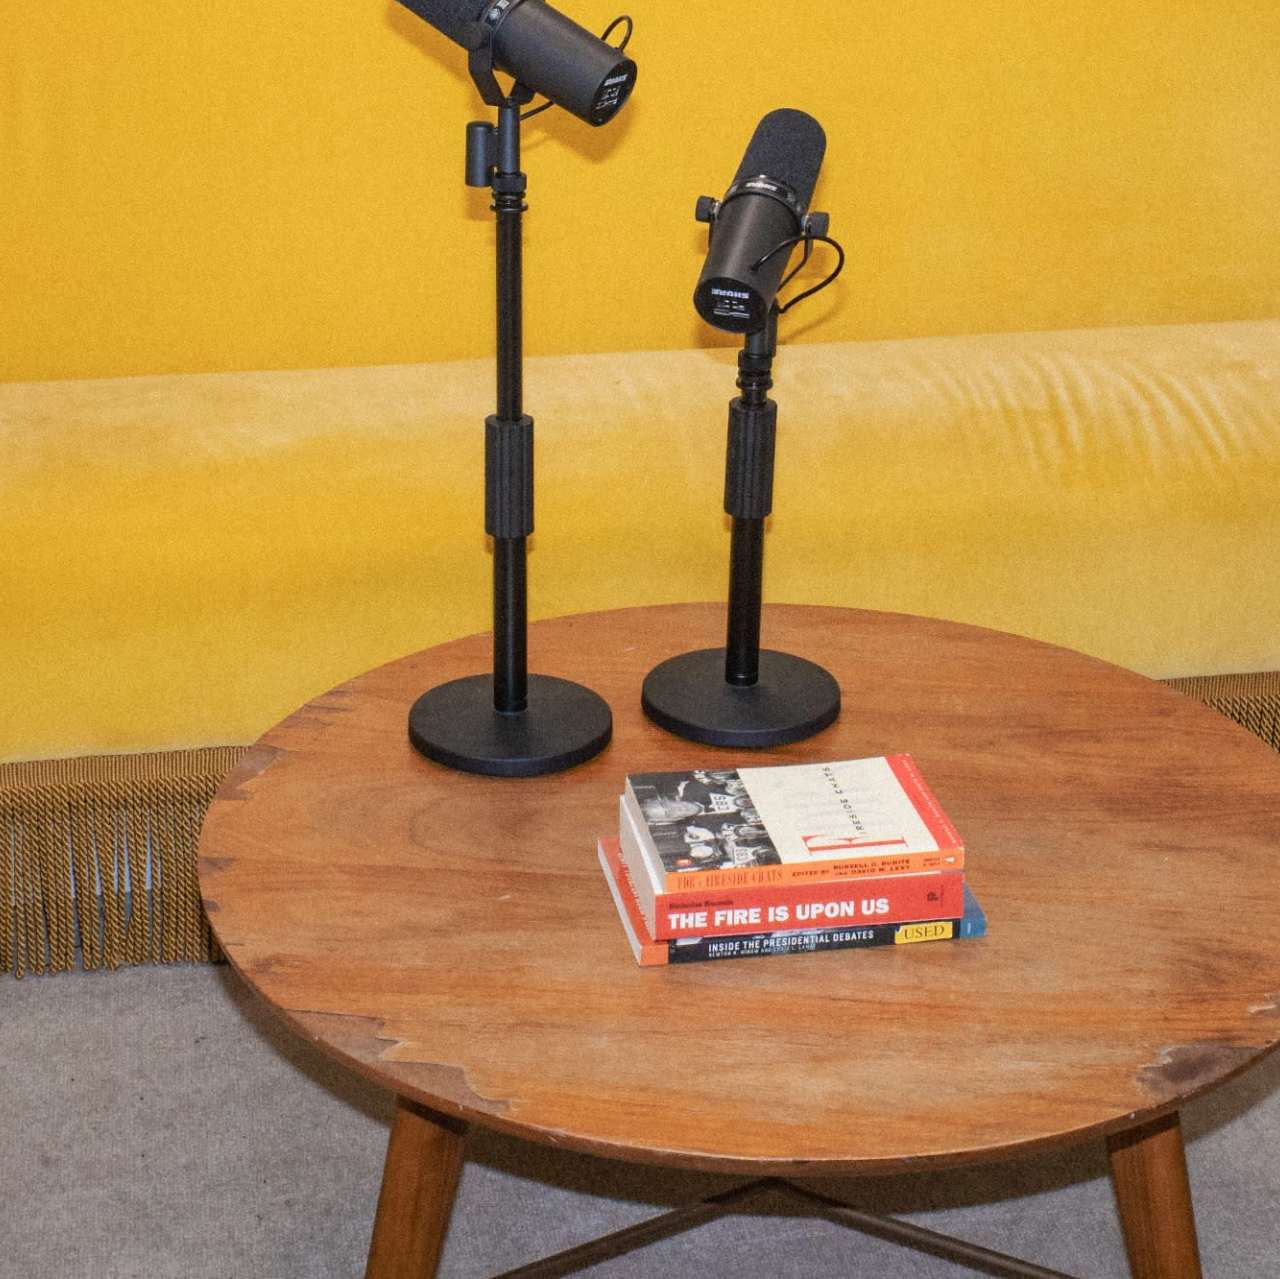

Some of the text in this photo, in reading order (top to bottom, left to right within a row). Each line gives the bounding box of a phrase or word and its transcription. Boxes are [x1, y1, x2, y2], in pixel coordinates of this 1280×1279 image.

[668, 898, 890, 929] THE FIRE IS UPON US
[708, 942, 740, 952] INSIDE
[743, 940, 760, 949] THE
[763, 933, 830, 947] PRESIDENTIAL
[833, 930, 874, 942] DEBATES
[904, 925, 945, 940] USED
